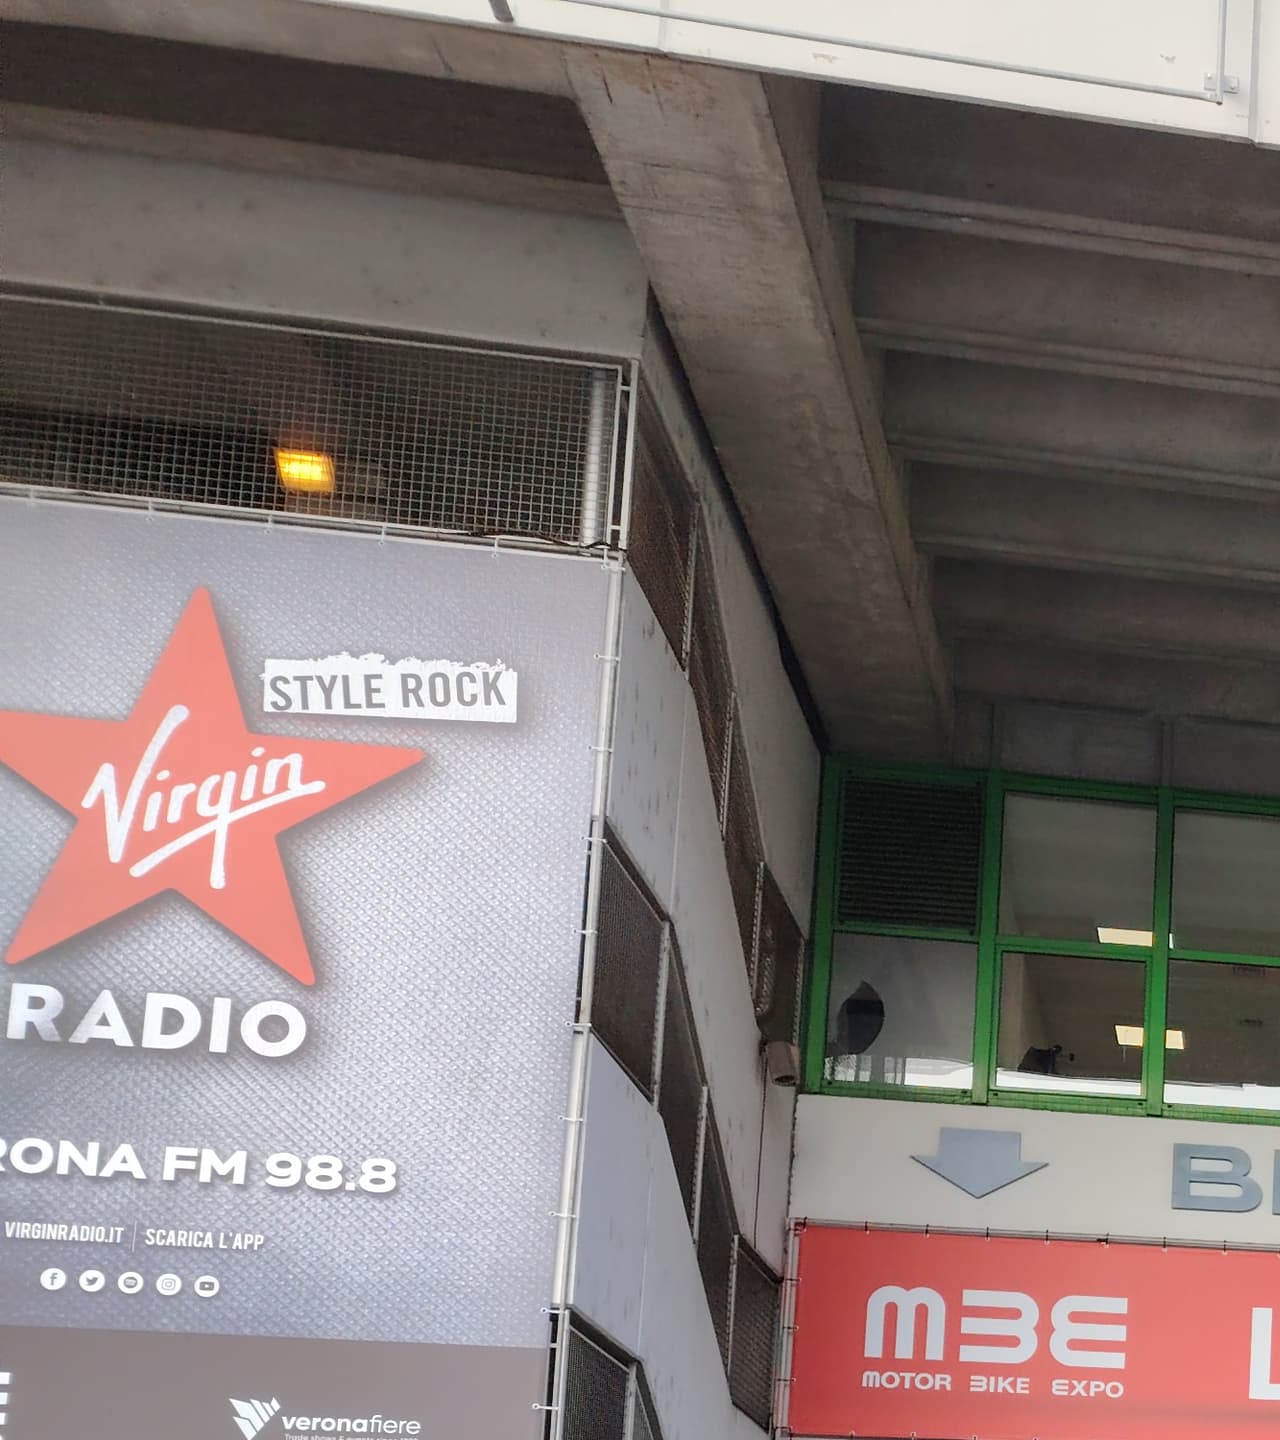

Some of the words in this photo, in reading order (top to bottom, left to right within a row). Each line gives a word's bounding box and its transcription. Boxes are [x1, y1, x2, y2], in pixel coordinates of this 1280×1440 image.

[269, 673, 386, 711] STYLE
[401, 670, 507, 709] ROCK
[81, 704, 326, 890] Virgin
[6, 982, 307, 1058] RADIO
[0, 1138, 146, 1180] ONA
[163, 1146, 247, 1184] FM
[265, 1152, 397, 1193] 98.8
[4, 1221, 124, 1243] VIRGINRADIO.IT
[145, 1229, 213, 1248] SCARICA
[219, 1231, 264, 1250] L'APP
[861, 1370, 952, 1391] MOTOR
[969, 1375, 1030, 1394] BIKE
[1051, 1379, 1124, 1398] EXPO
[282, 1414, 421, 1434] veronafiere
